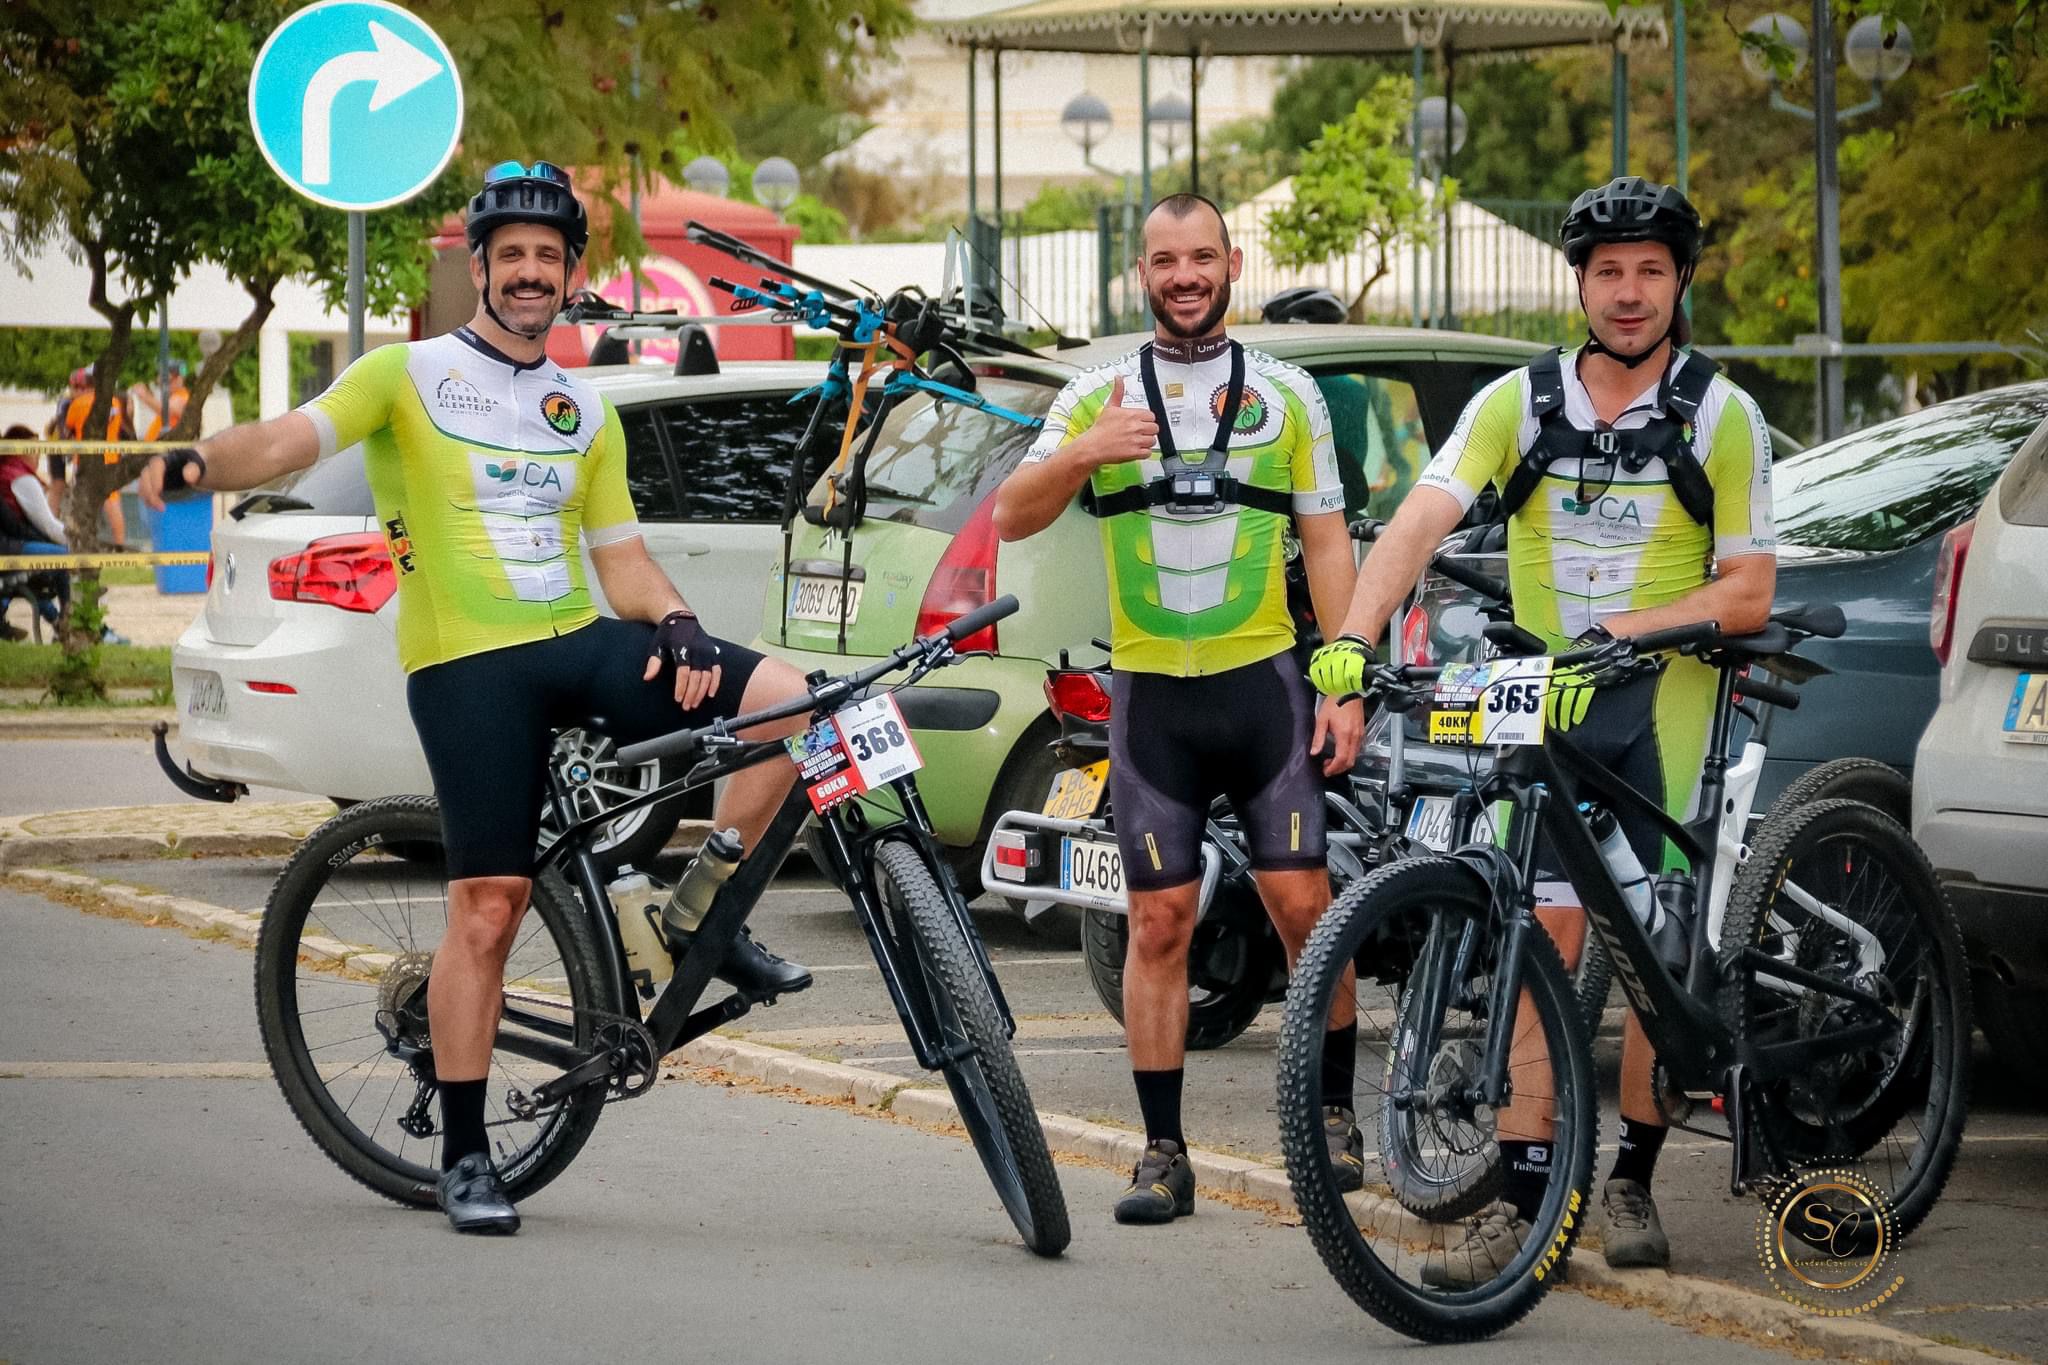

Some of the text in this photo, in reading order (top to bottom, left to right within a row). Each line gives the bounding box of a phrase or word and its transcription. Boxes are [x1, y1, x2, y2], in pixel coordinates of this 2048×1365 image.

[438, 401, 492, 412] ALENTEJO
[1536, 395, 1551, 403] XC
[1751, 399, 1771, 485] Agrobeja
[523, 462, 562, 492] CA
[1599, 497, 1642, 526] CA
[795, 583, 825, 614] 3069
[1488, 684, 1540, 714] 365
[1438, 716, 1469, 728] 40KM
[851, 720, 905, 761] 368
[816, 775, 849, 799] 60KM
[327, 833, 384, 869] DT SWISS
[1073, 847, 1121, 893] 0468
[1587, 906, 1658, 1016] SCOTT
[501, 1145, 543, 1183] MEZC
[1534, 1189, 1582, 1281] MAXXIS
